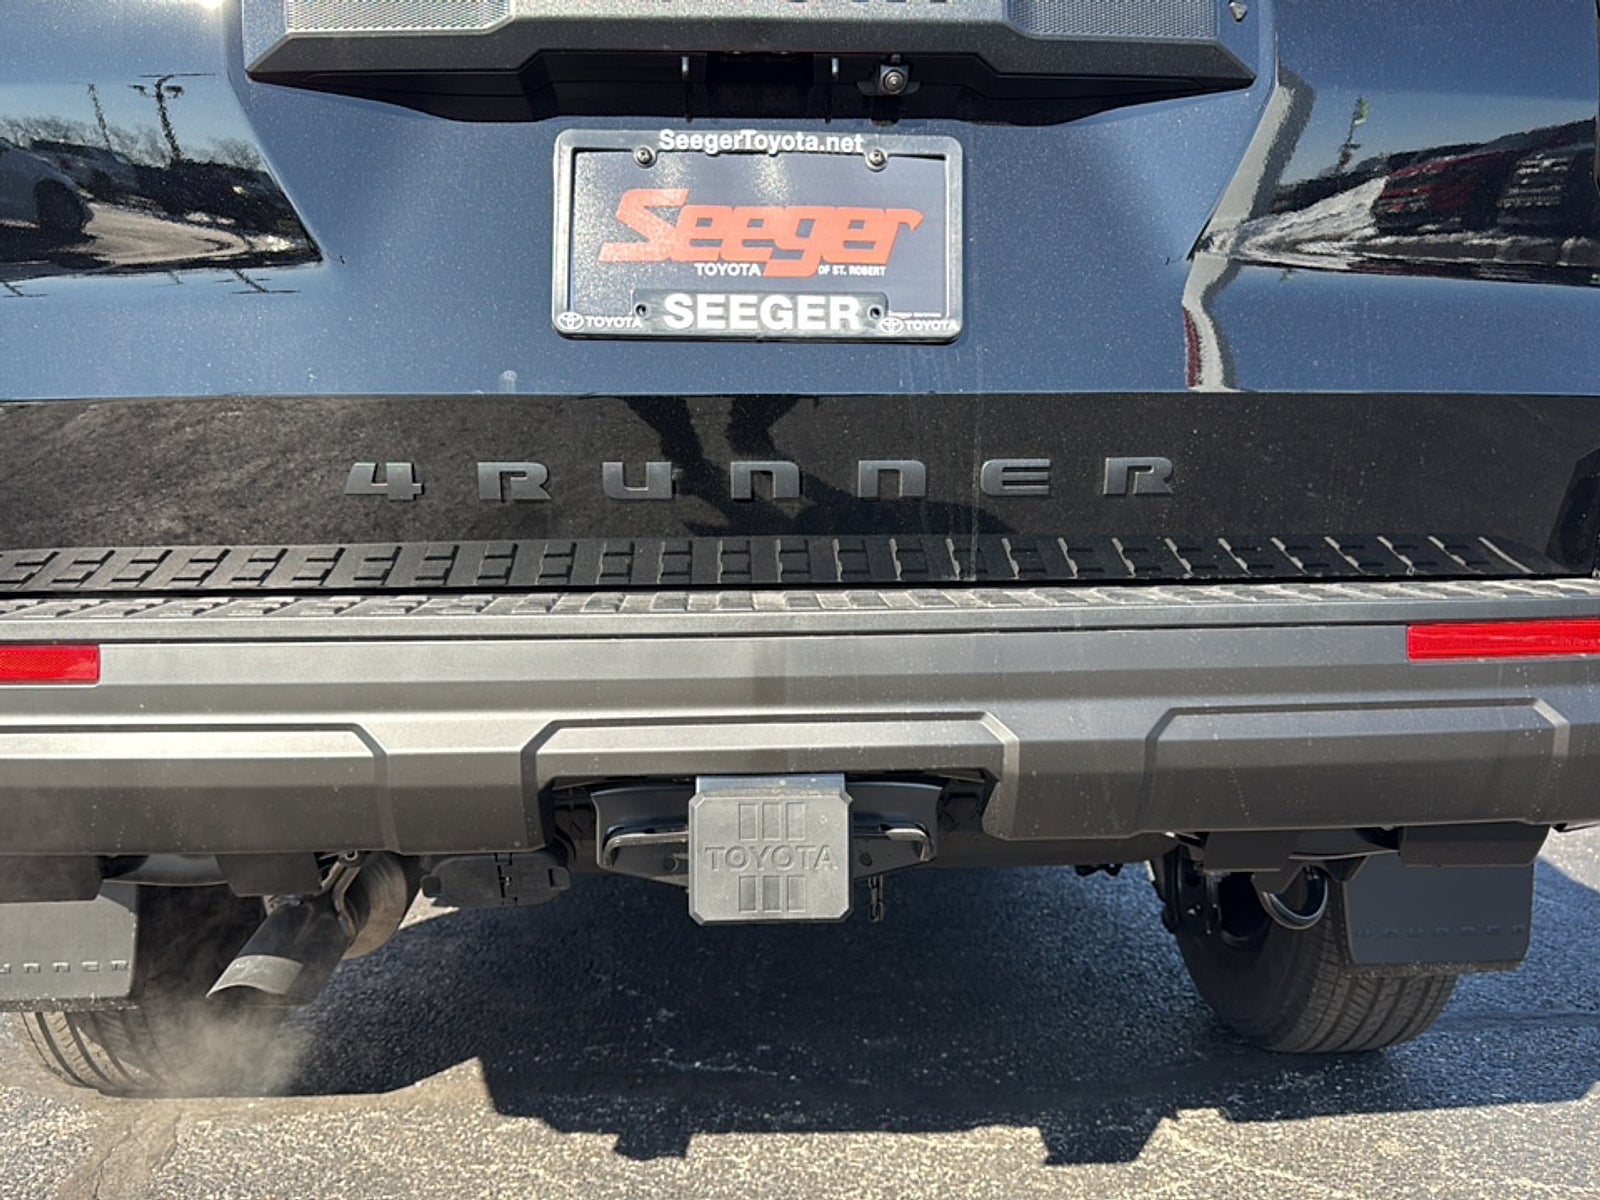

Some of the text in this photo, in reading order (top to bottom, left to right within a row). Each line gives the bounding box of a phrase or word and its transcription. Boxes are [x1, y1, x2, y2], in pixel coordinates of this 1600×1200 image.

[658, 128, 865, 156] SeegerToyota.net
[599, 188, 924, 278] Seeger
[694, 262, 762, 277] TOYOTA
[817, 265, 886, 277] OF ST. ROBERT
[585, 316, 643, 328] TOYOTA
[663, 293, 863, 331] SEEGER
[904, 320, 959, 332] TOYOTA
[704, 845, 840, 872] TOYOTA
